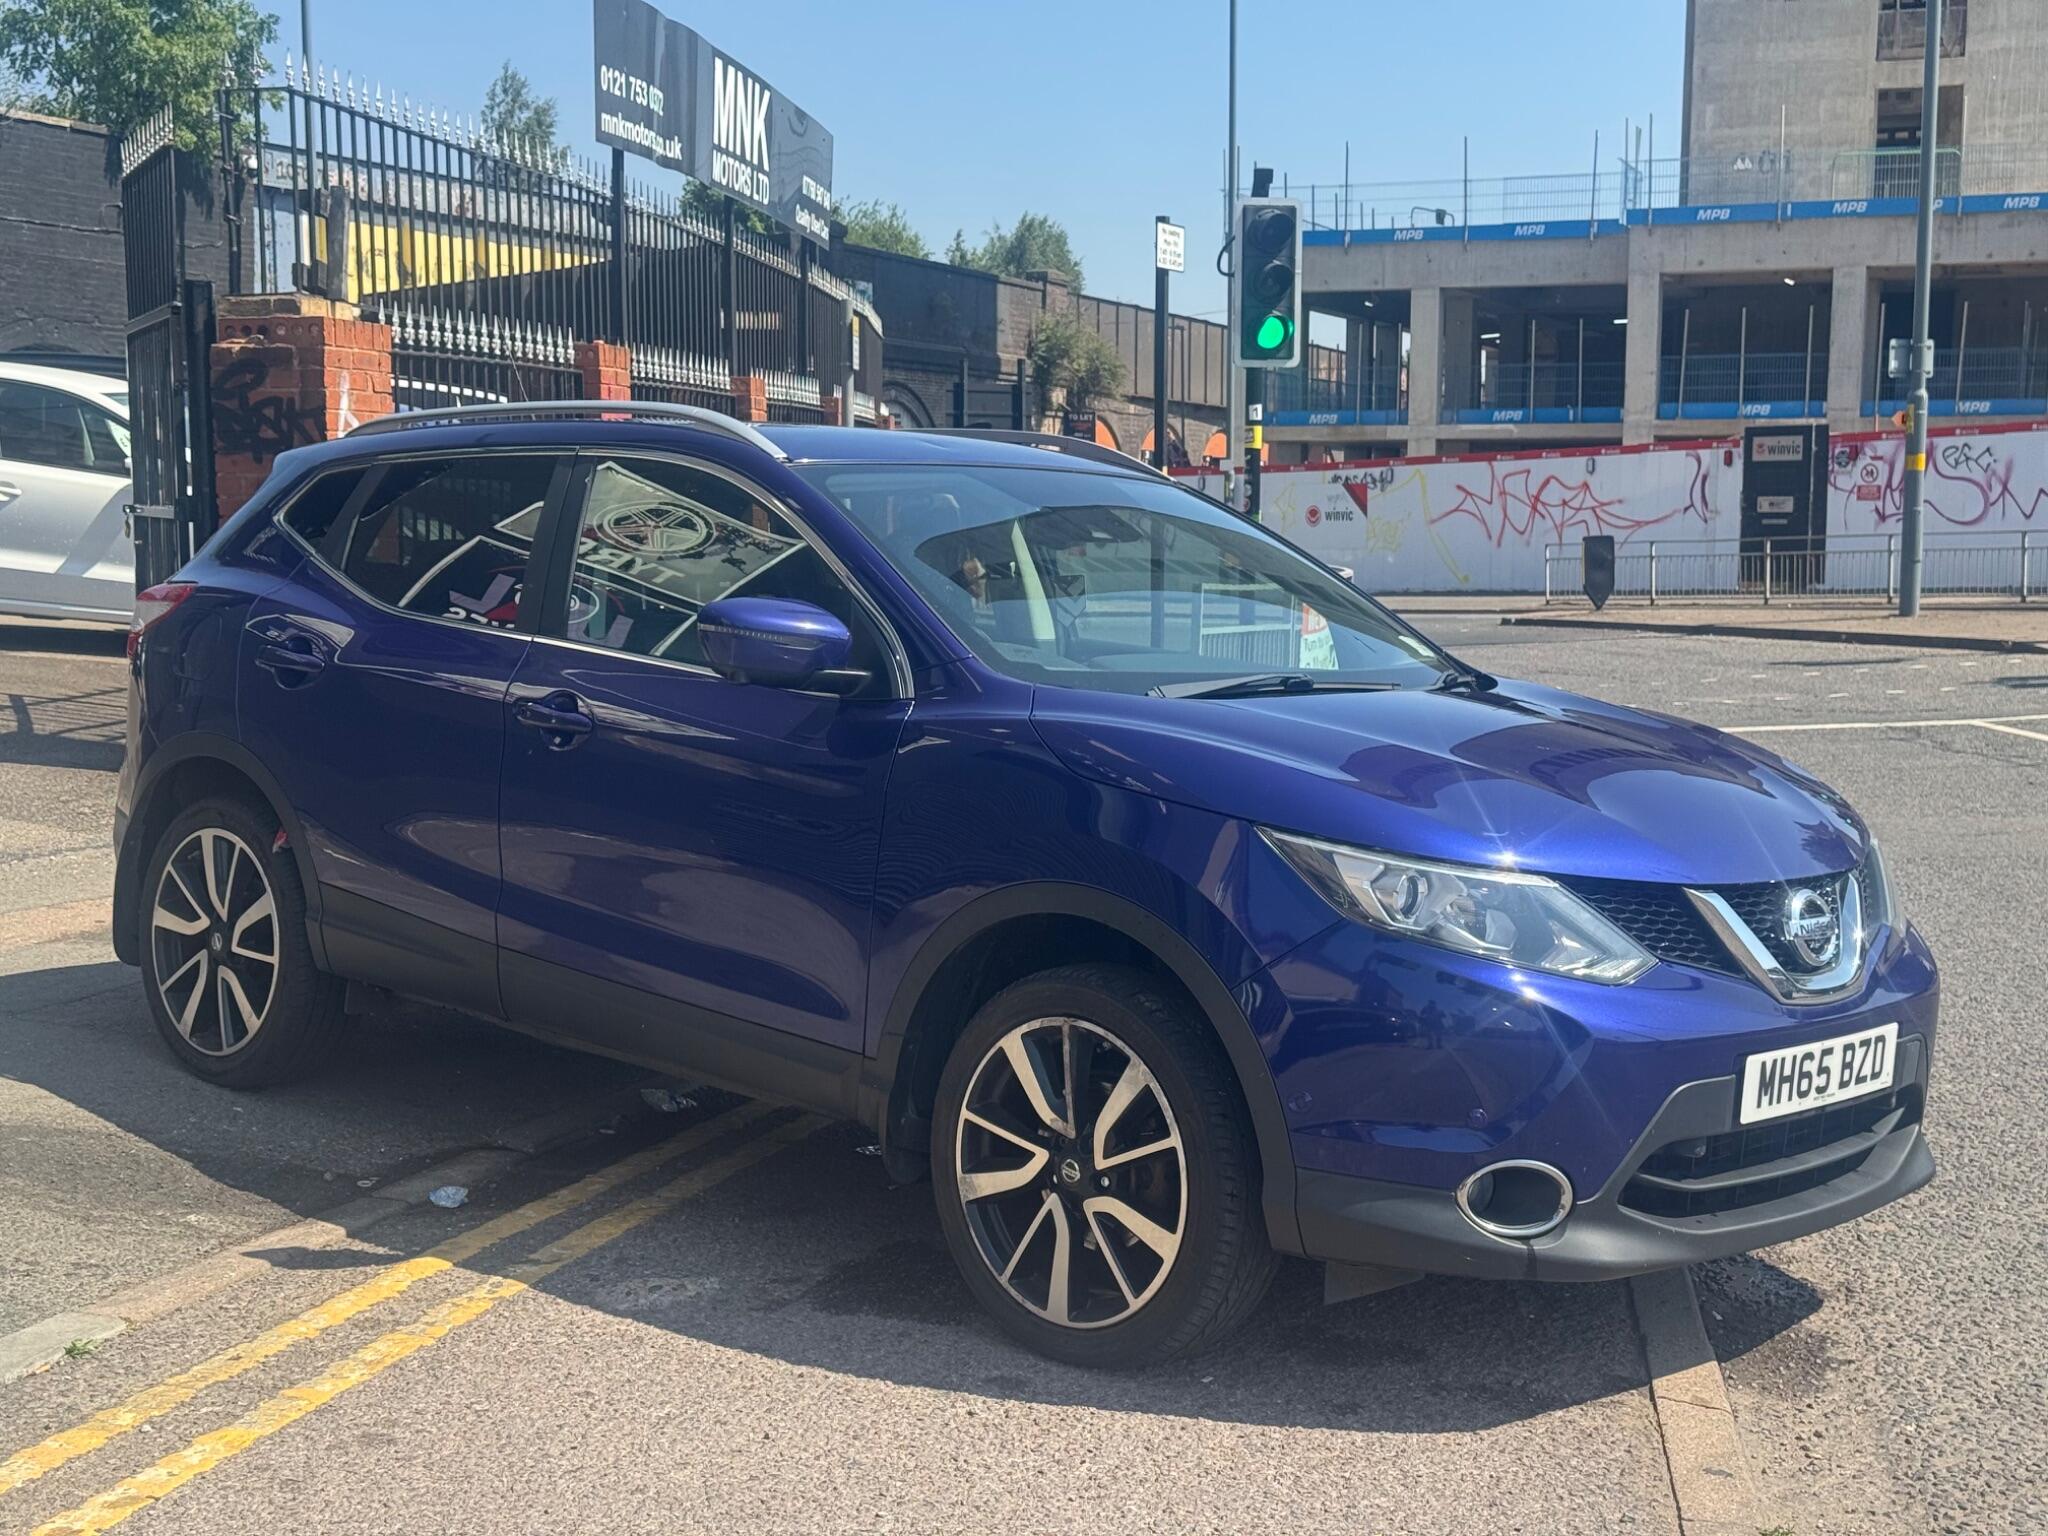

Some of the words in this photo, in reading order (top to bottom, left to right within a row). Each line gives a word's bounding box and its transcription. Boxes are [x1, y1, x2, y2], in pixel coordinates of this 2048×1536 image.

[600, 64, 626, 98] 0121
[628, 75, 648, 107] 753
[713, 56, 771, 172] MNK
[712, 149, 752, 197] MOTORS
[753, 170, 770, 205] LTD
[1832, 201, 1867, 214] MPB
[2003, 196, 2040, 209] MPB
[1696, 208, 1730, 221] MPB
[1394, 229, 1424, 241] MPB
[1514, 224, 1546, 236] MPB
[1740, 404, 1771, 416] MPB
[1959, 402, 1990, 414] MPB
[1309, 414, 1338, 425] MPB
[1492, 410, 1522, 421] MPB
[1767, 441, 1801, 456] winvic
[1324, 507, 1354, 522] winvic
[1757, 1047, 1834, 1109] MH65
[1838, 1034, 1887, 1090] BZD
